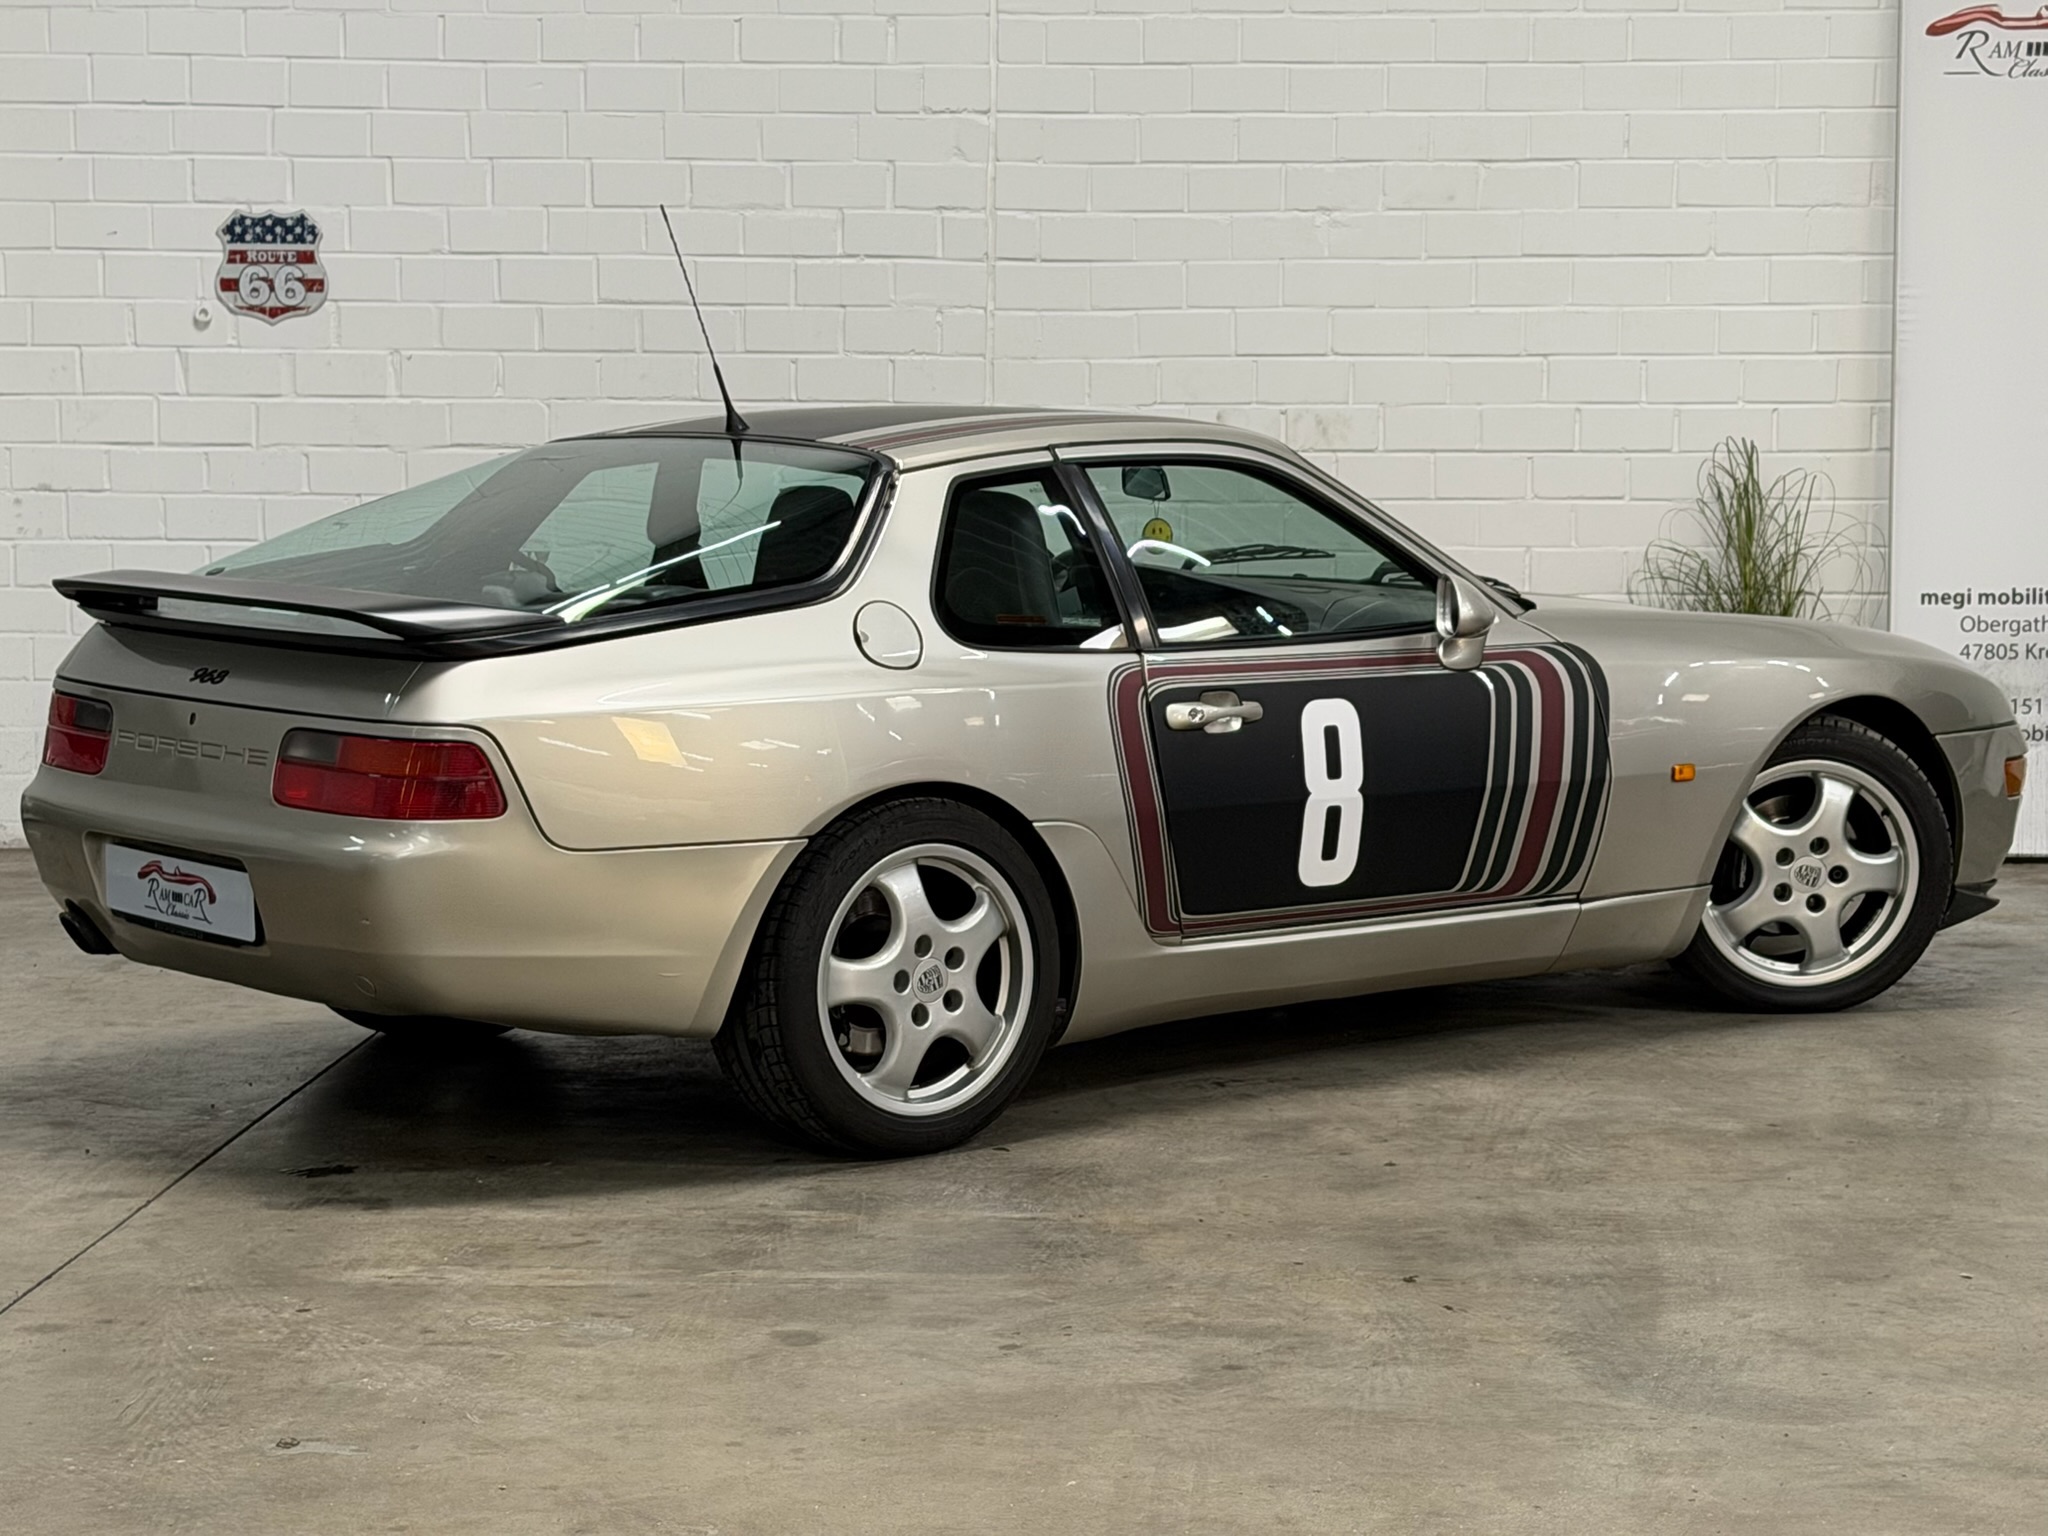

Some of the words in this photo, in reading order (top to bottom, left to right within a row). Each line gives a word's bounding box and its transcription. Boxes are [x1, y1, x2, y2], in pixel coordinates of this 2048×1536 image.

[1956, 30, 2023, 77] RAM
[246, 250, 298, 263] ROUTE
[238, 264, 308, 308] 66
[1920, 587, 1972, 609] megi
[1959, 643, 2019, 660] 47805
[2025, 643, 2048, 660] Kr
[189, 667, 230, 685] 968
[115, 728, 270, 767] PORSCHE
[1298, 697, 1365, 888] 8
[147, 877, 173, 914] RAM
[183, 887, 214, 925] CAR
